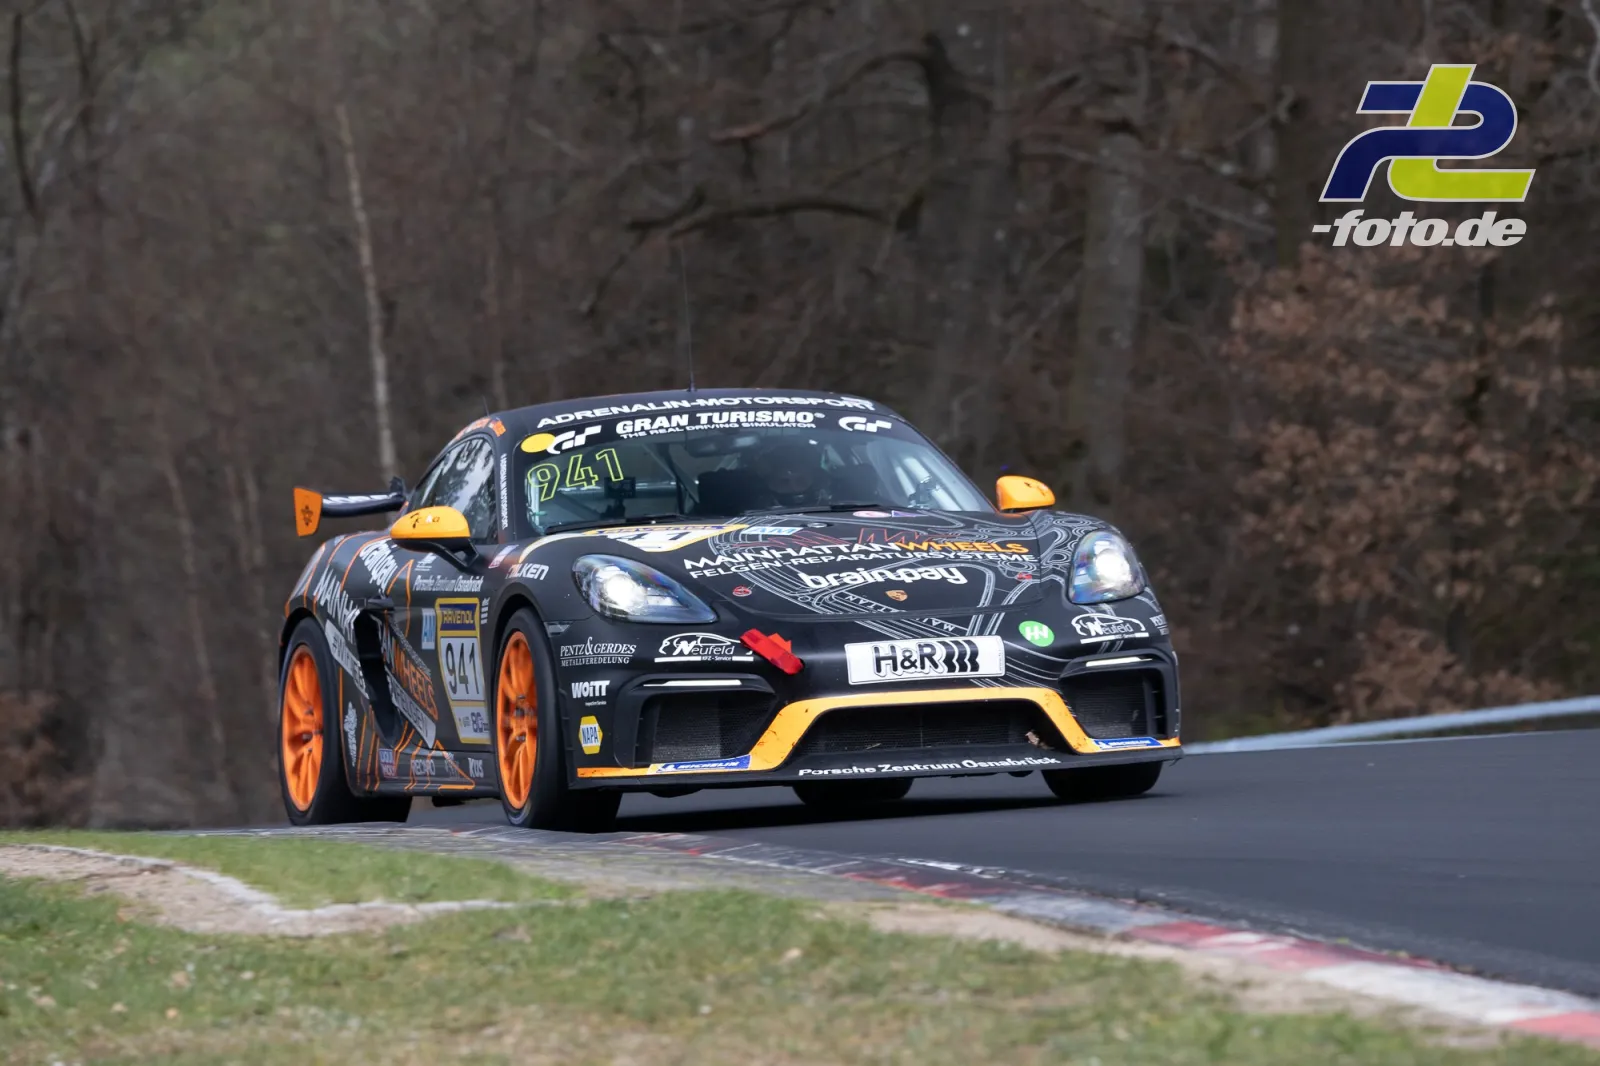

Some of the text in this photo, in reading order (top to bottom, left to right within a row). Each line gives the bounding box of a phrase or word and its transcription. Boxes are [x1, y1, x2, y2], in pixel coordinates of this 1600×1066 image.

[616, 413, 690, 435] GRAN
[649, 427, 684, 437] REAL
[685, 423, 740, 431] DRIVING
[741, 421, 817, 429] SIMULATOR
[527, 448, 625, 502] 941
[797, 567, 968, 589] brainpay
[1086, 620, 1134, 637] Neufeld
[672, 639, 736, 656] Neufeld
[445, 642, 480, 695] 941
[561, 656, 630, 667] METALLVEREDELUNG
[874, 645, 938, 674] H&R
[582, 726, 599, 745] NAPA
[798, 756, 1062, 776] Porsche Zentrum Osnabrück
